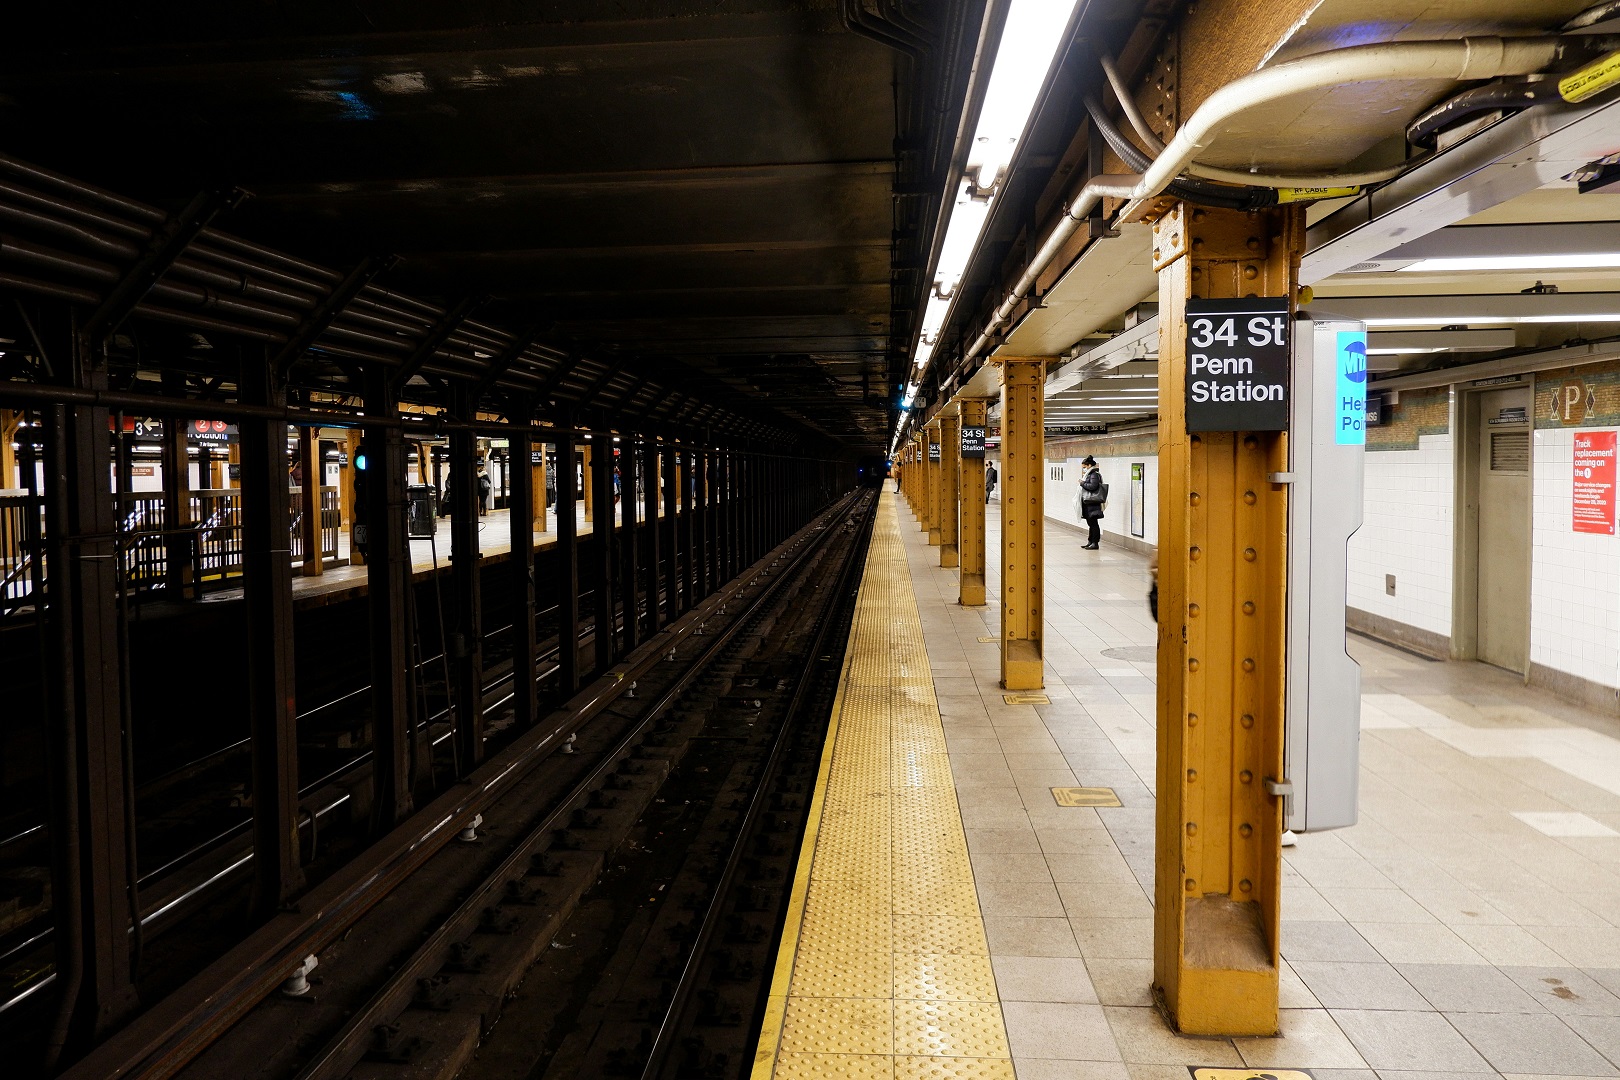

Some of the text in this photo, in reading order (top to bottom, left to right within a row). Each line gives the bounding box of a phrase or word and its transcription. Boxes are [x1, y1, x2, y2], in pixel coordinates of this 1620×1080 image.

[1192, 316, 1285, 348] 34 St
[1191, 353, 1253, 375] Penn
[1191, 380, 1284, 402] Station
[1564, 385, 1580, 420] P
[136, 422, 142, 436] 3
[200, 420, 222, 429] 2 3
[962, 429, 985, 438] 34 St
[1575, 439, 1591, 448] Track
[1574, 449, 1613, 459] replacement
[1574, 458, 1605, 468] coming on
[1574, 468, 1584, 477] the
